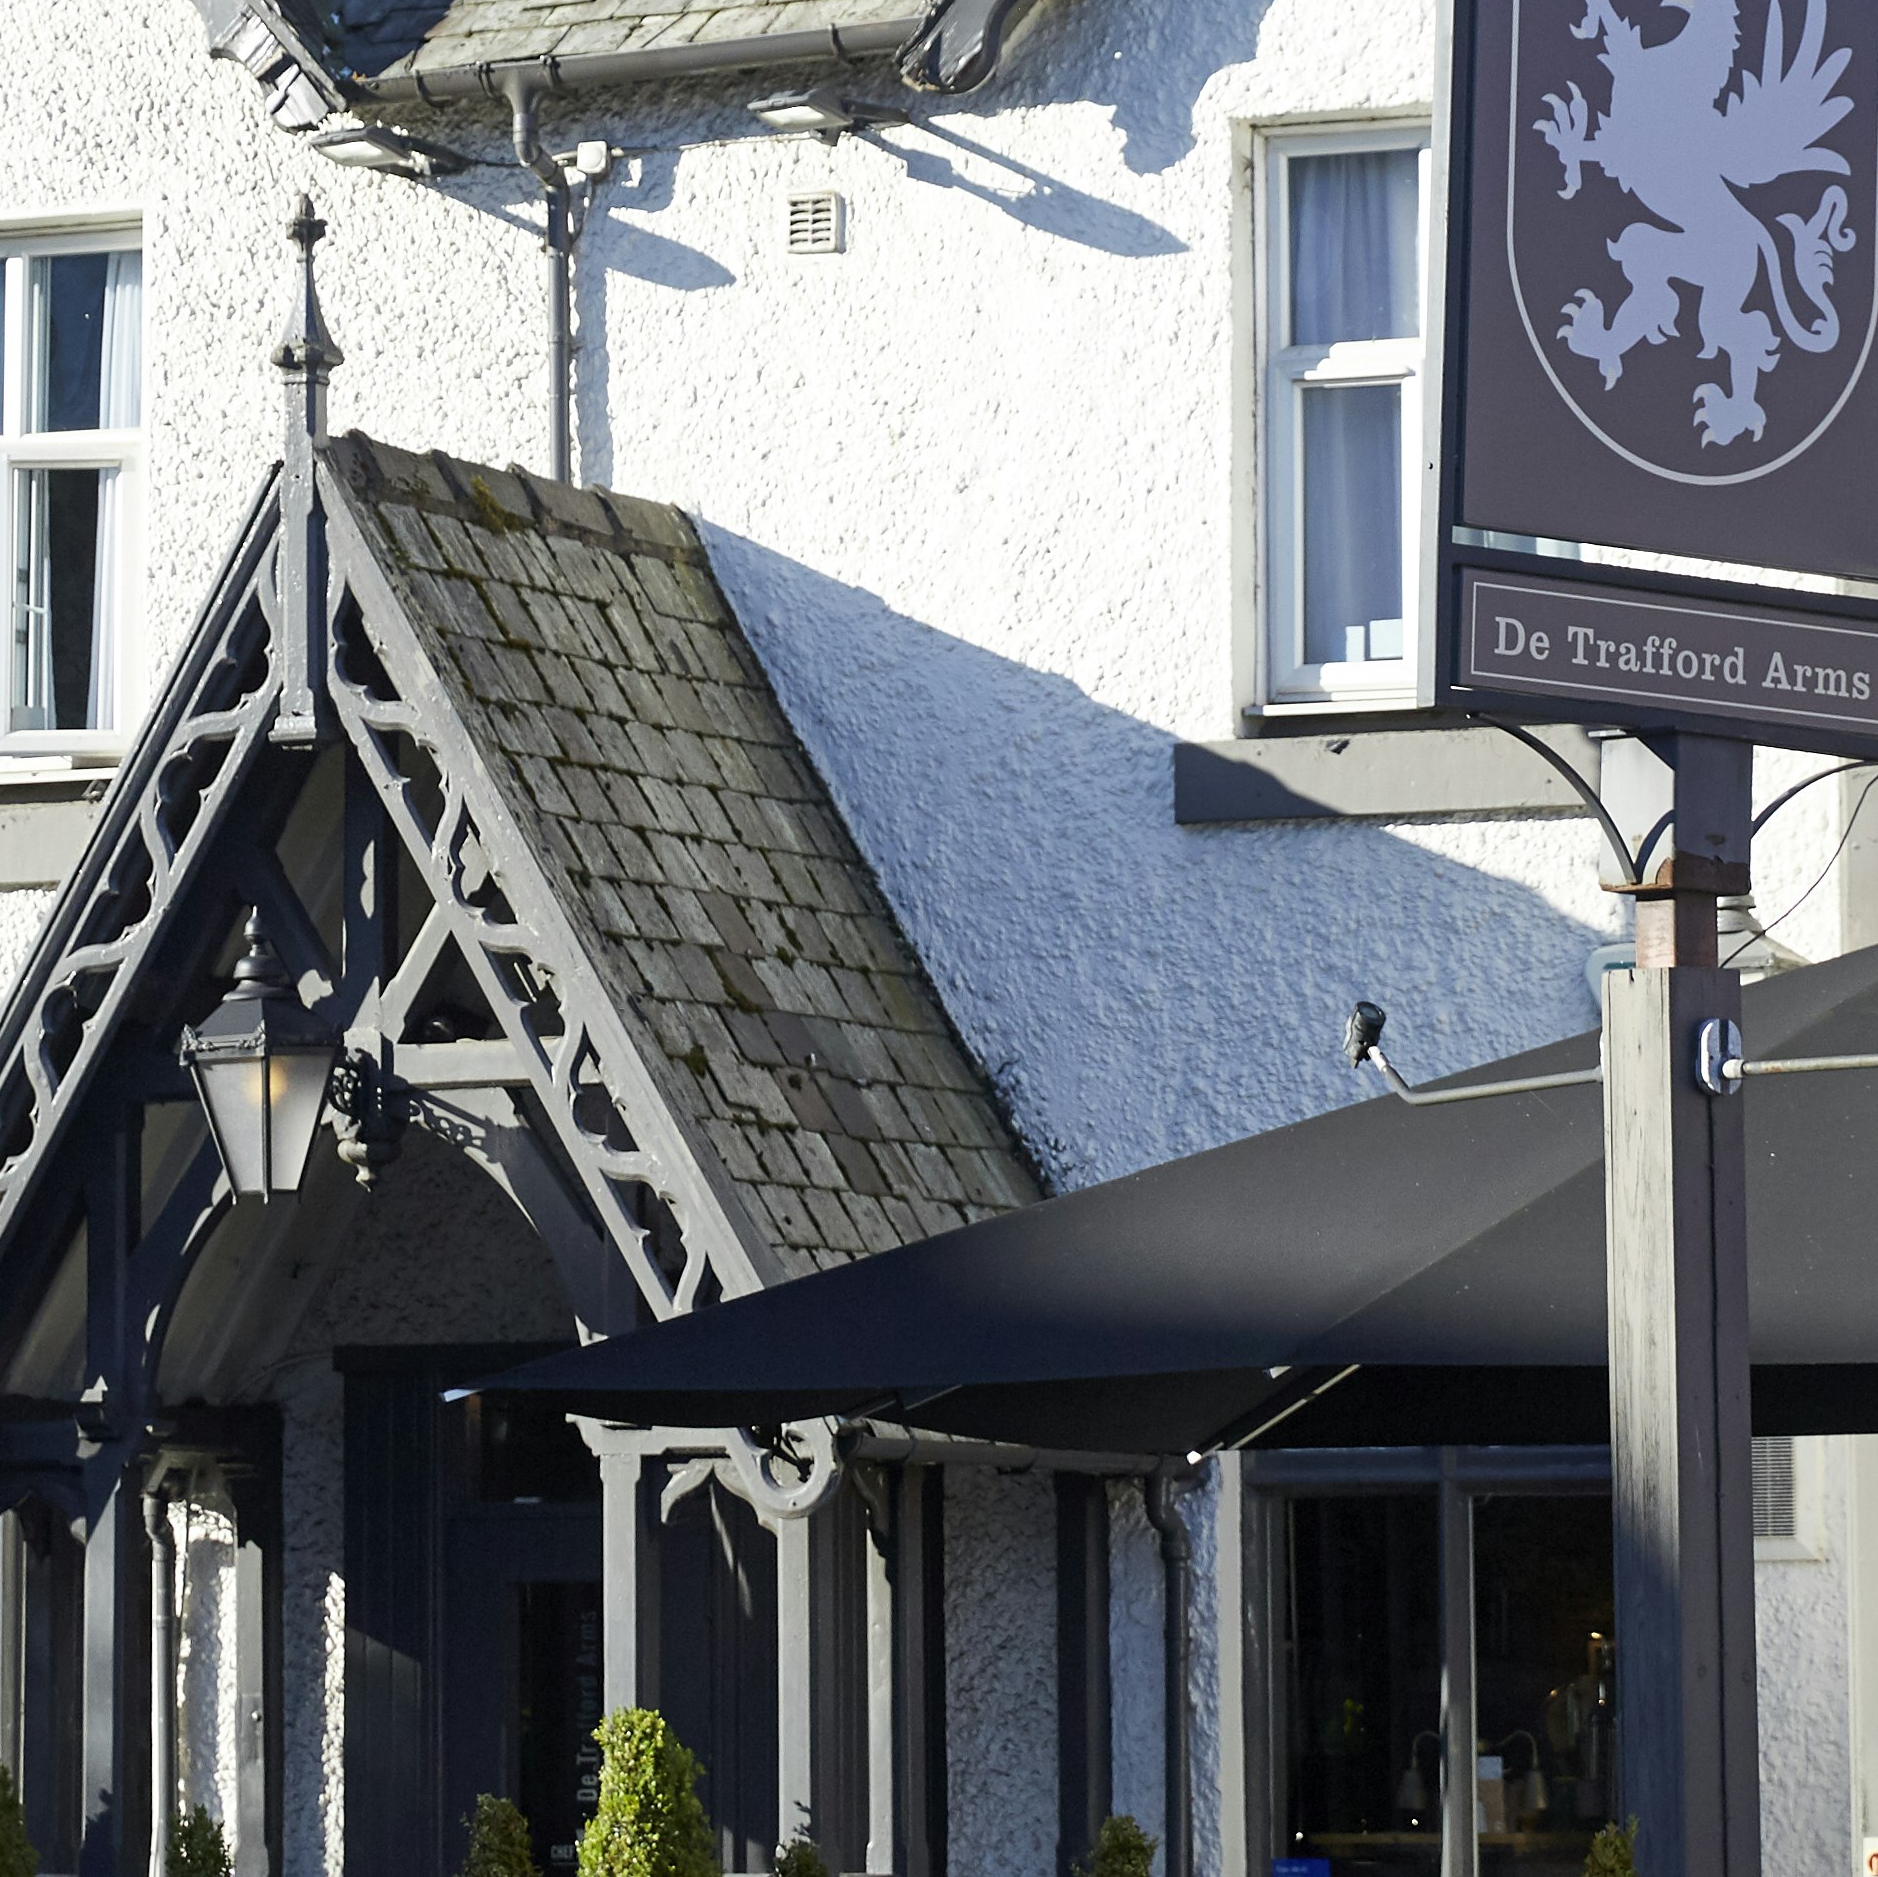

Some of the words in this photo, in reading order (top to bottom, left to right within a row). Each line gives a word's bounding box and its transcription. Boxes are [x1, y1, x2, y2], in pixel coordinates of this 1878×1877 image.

[1493, 616, 1550, 660] De
[1567, 625, 1746, 685] Trafford
[1761, 651, 1872, 700] Arms
